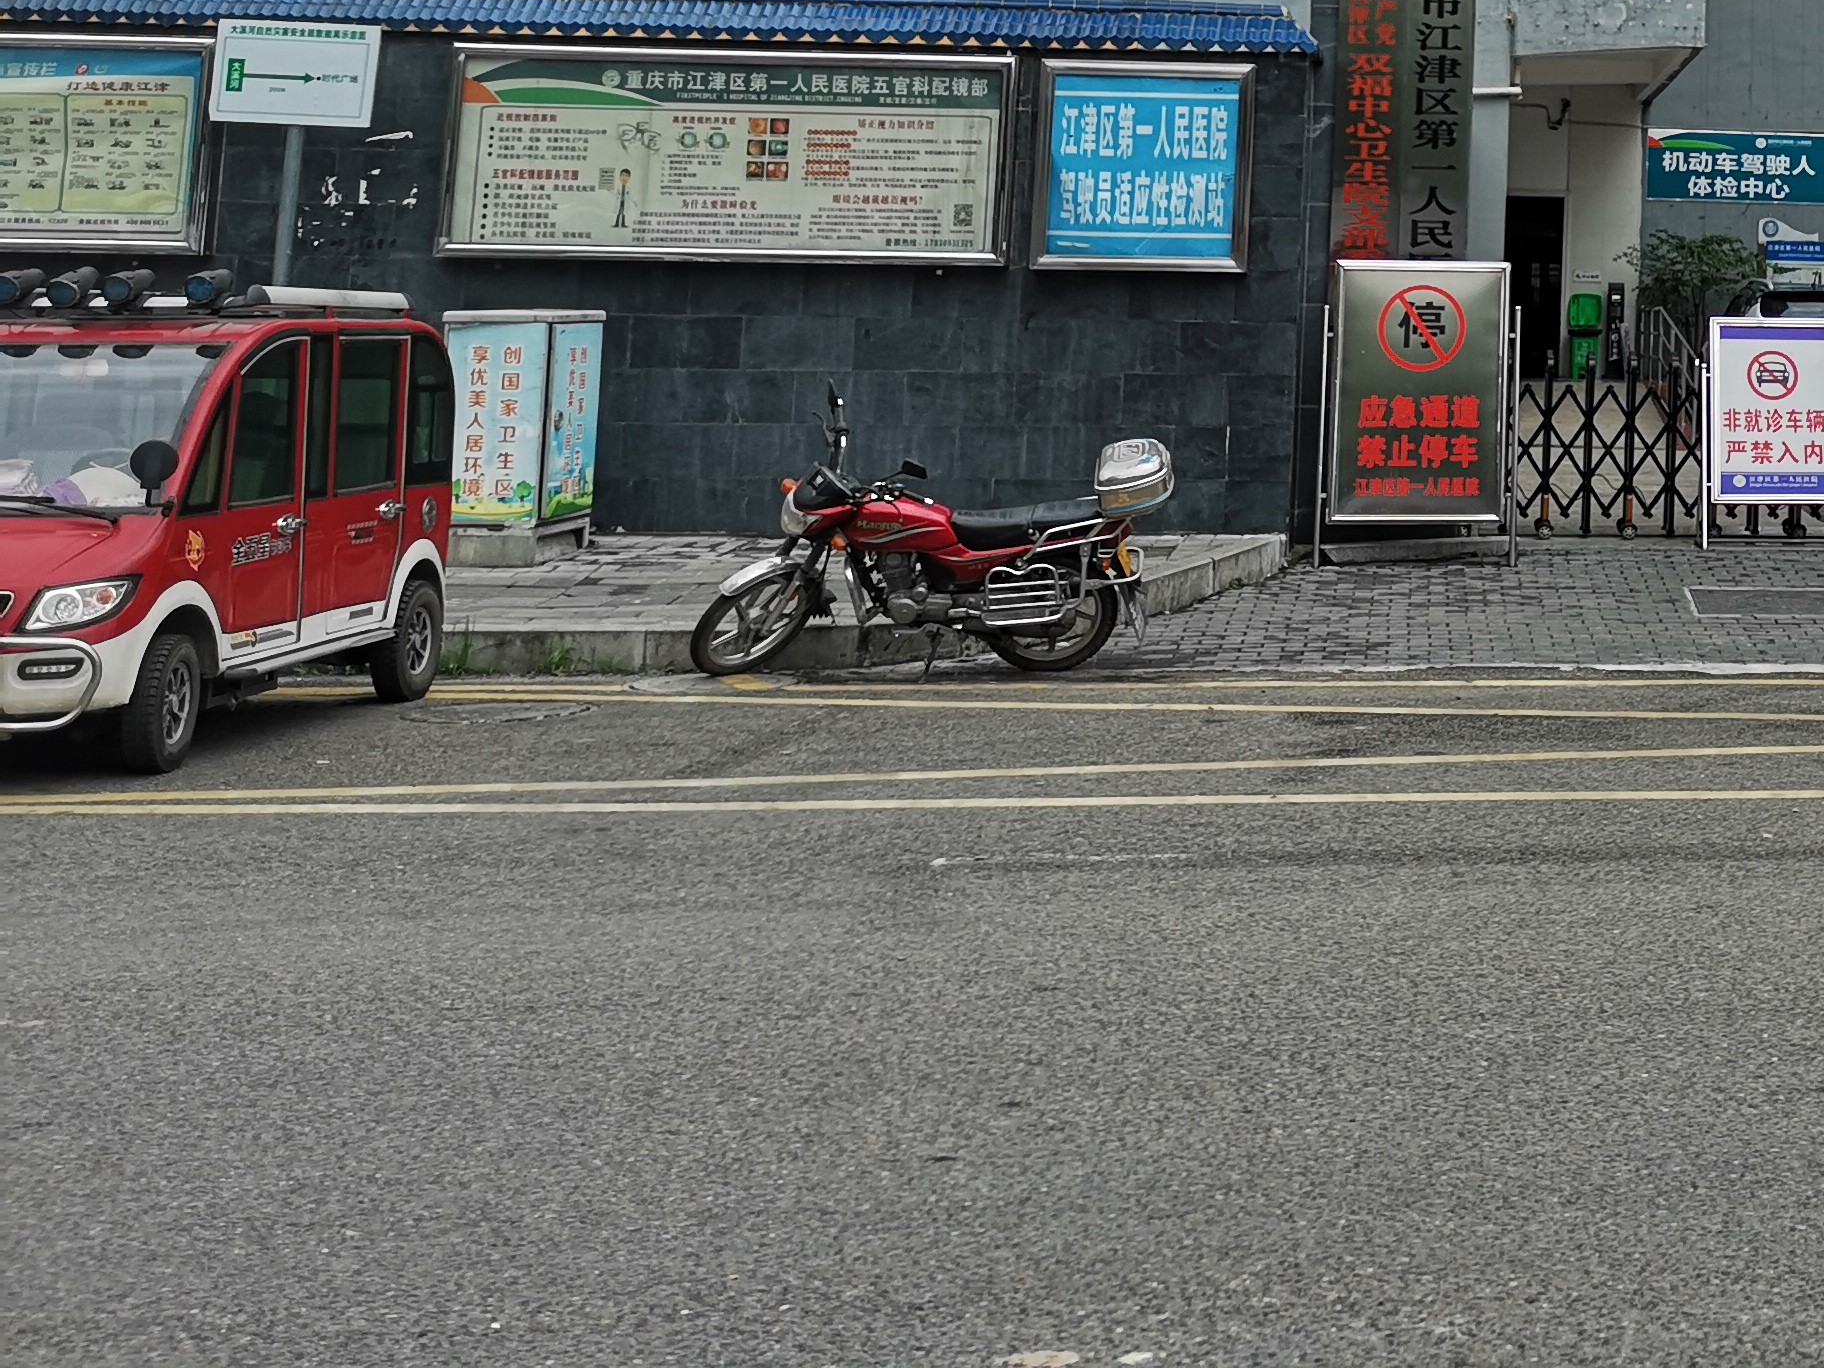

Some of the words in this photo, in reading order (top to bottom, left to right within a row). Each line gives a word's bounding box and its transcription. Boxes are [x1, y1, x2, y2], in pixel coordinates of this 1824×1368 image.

[0, 62, 58, 77] 宣传栏
[624, 69, 989, 97] 重庆市江津区第一人民医院五官科配镜部
[1060, 102, 1228, 160] 江津区第一人民医院
[1662, 150, 1816, 177] 机动车驾驶人
[1060, 169, 1226, 228] 驾驶员适应性检测站
[1687, 175, 1791, 200] 体检中心
[1397, 301, 1446, 349] 停
[461, 345, 491, 497] 享优美人居环境
[494, 346, 522, 498] 创国家卫生区
[1357, 394, 1481, 429] 应急通道
[1356, 434, 1479, 469] 禁止停车
[1724, 440, 1824, 465] 严禁入内
[1354, 477, 1481, 497] 江津区第一人民医院
